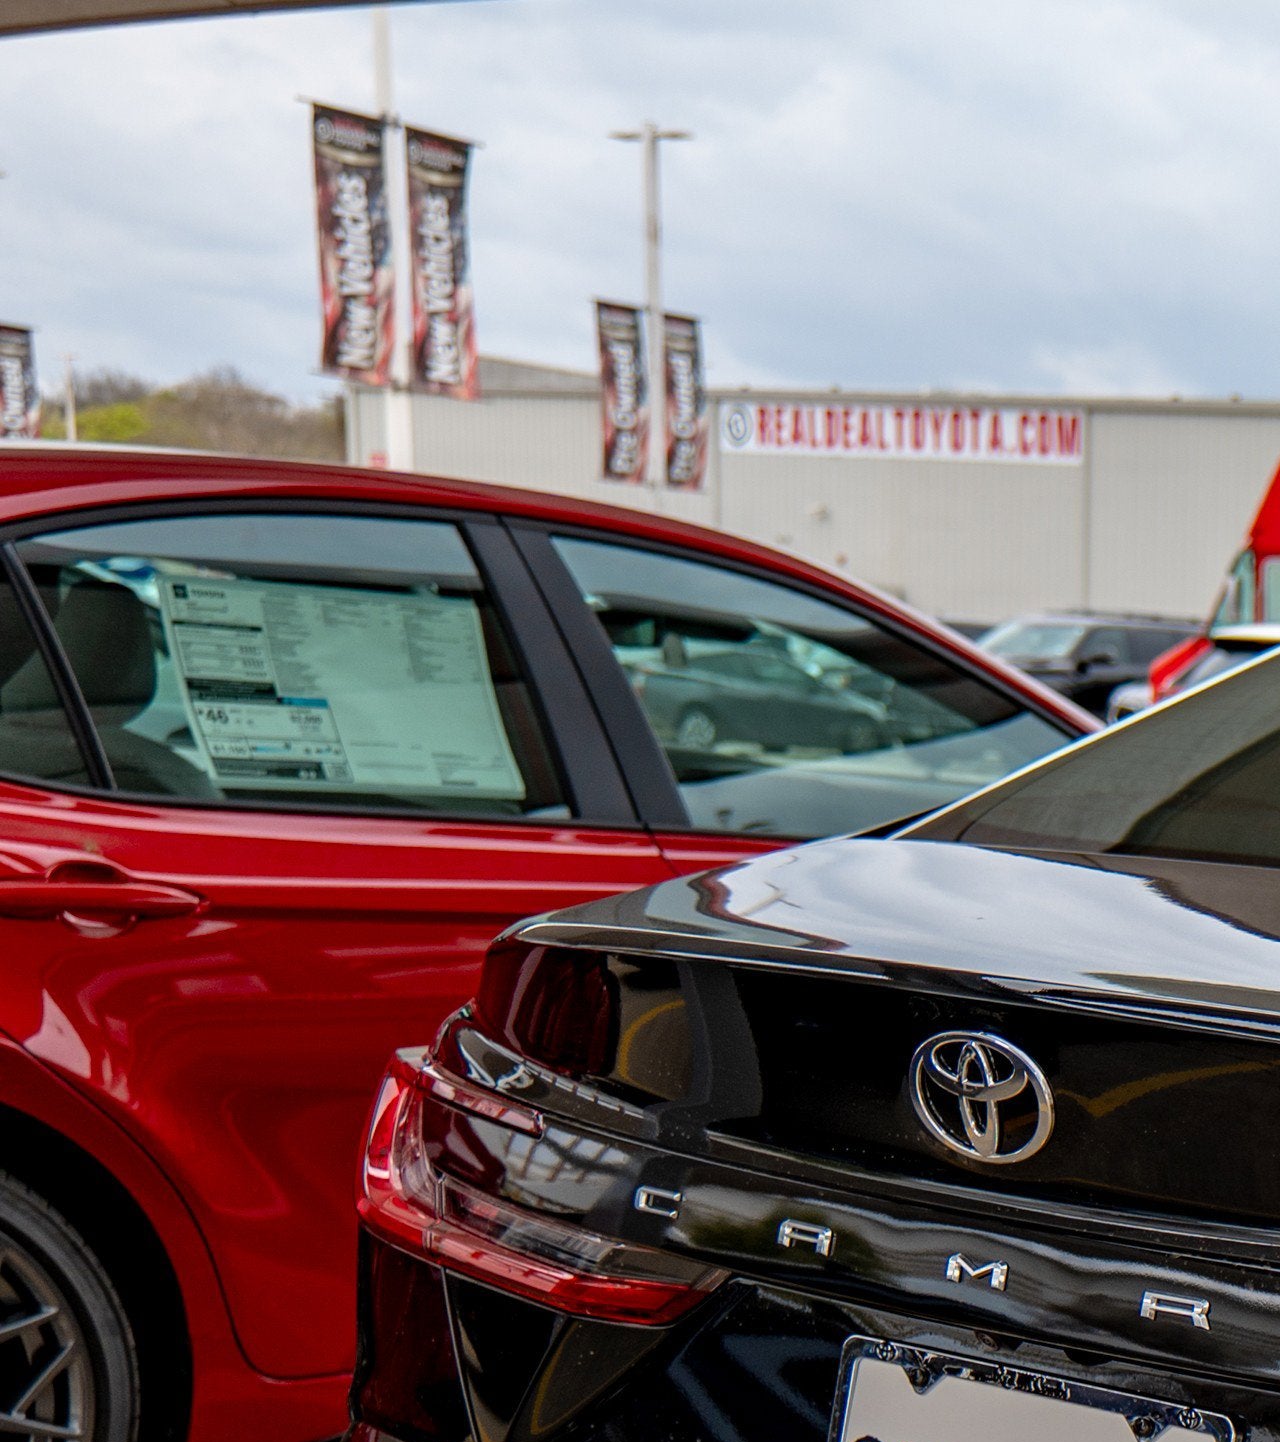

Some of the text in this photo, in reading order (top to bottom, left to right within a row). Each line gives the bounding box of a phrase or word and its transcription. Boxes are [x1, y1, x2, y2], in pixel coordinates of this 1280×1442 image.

[332, 171, 374, 296] Vehicles
[417, 192, 455, 313] Vehicles
[336, 297, 376, 370] New
[425, 314, 460, 384] New
[756, 407, 1082, 456] REALDEALTOYOTA.COM
